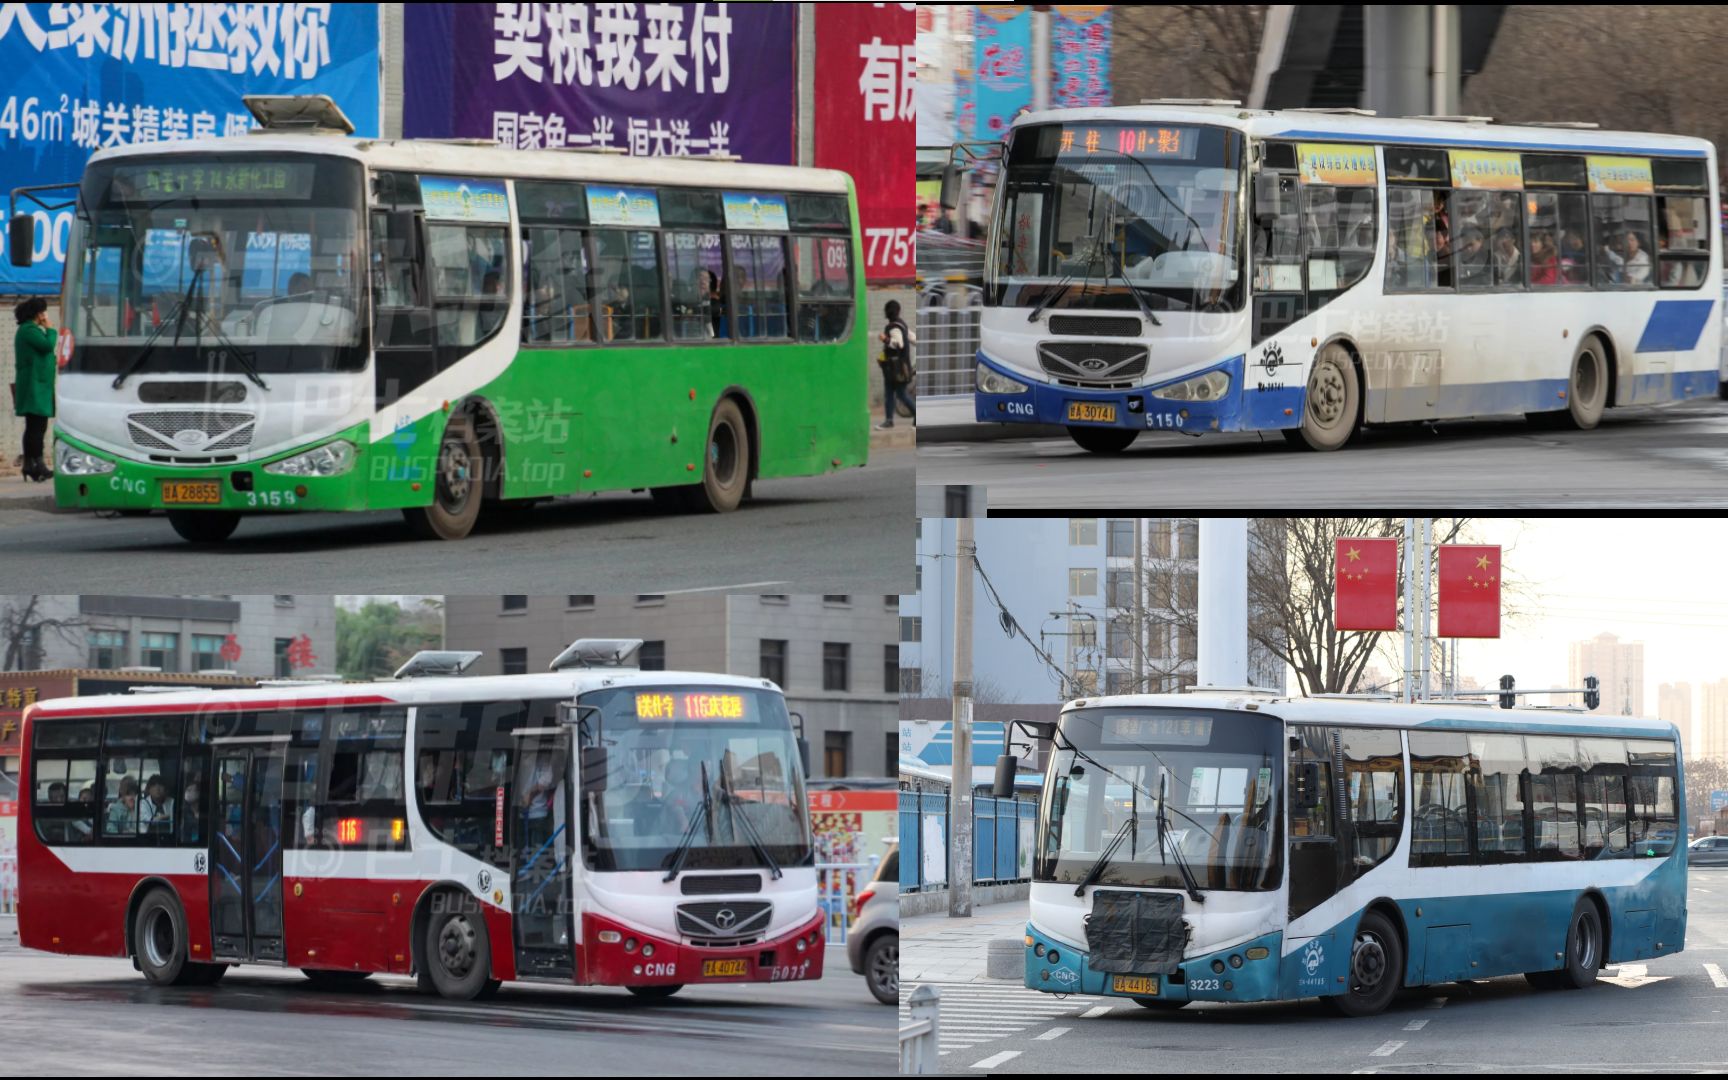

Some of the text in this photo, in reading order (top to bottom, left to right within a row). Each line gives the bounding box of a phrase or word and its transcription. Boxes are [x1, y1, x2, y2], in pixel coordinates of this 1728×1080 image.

[493, 3, 732, 93] 契税我来付
[1007, 402, 1034, 415] CNG
[1146, 412, 1184, 427] 5150
[110, 476, 146, 495] CNG
[645, 963, 676, 976] CNG
[1190, 980, 1219, 990] 3223
